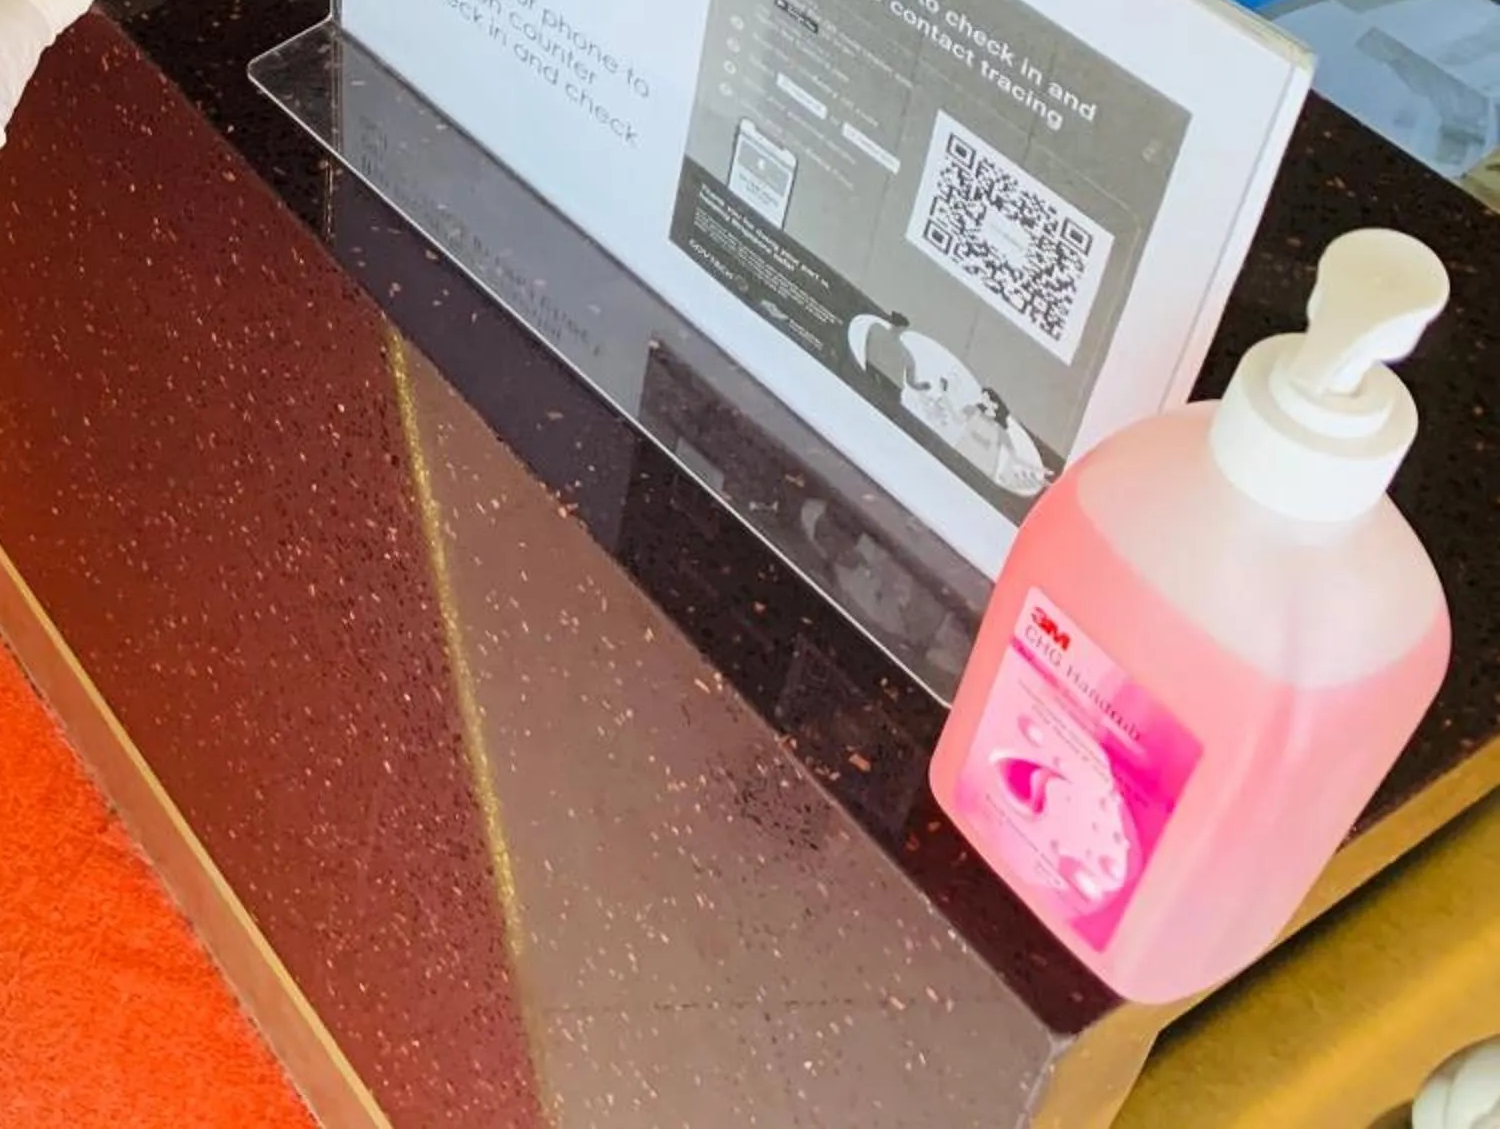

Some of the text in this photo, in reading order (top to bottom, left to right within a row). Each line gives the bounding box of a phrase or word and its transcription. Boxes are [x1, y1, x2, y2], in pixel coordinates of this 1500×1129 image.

[488, 16, 508, 47] in
[513, 42, 559, 85] and
[565, 82, 640, 148] check
[509, 10, 596, 85] counter
[541, 8, 619, 74] phone
[626, 66, 650, 98] to
[889, 0, 975, 69] contact
[980, 59, 1064, 132] tracing
[945, 8, 1015, 67] check
[1020, 57, 1043, 87] in
[1048, 81, 1098, 123] and
[1024, 624, 1063, 667] CHG
[1030, 606, 1071, 651] 3M
